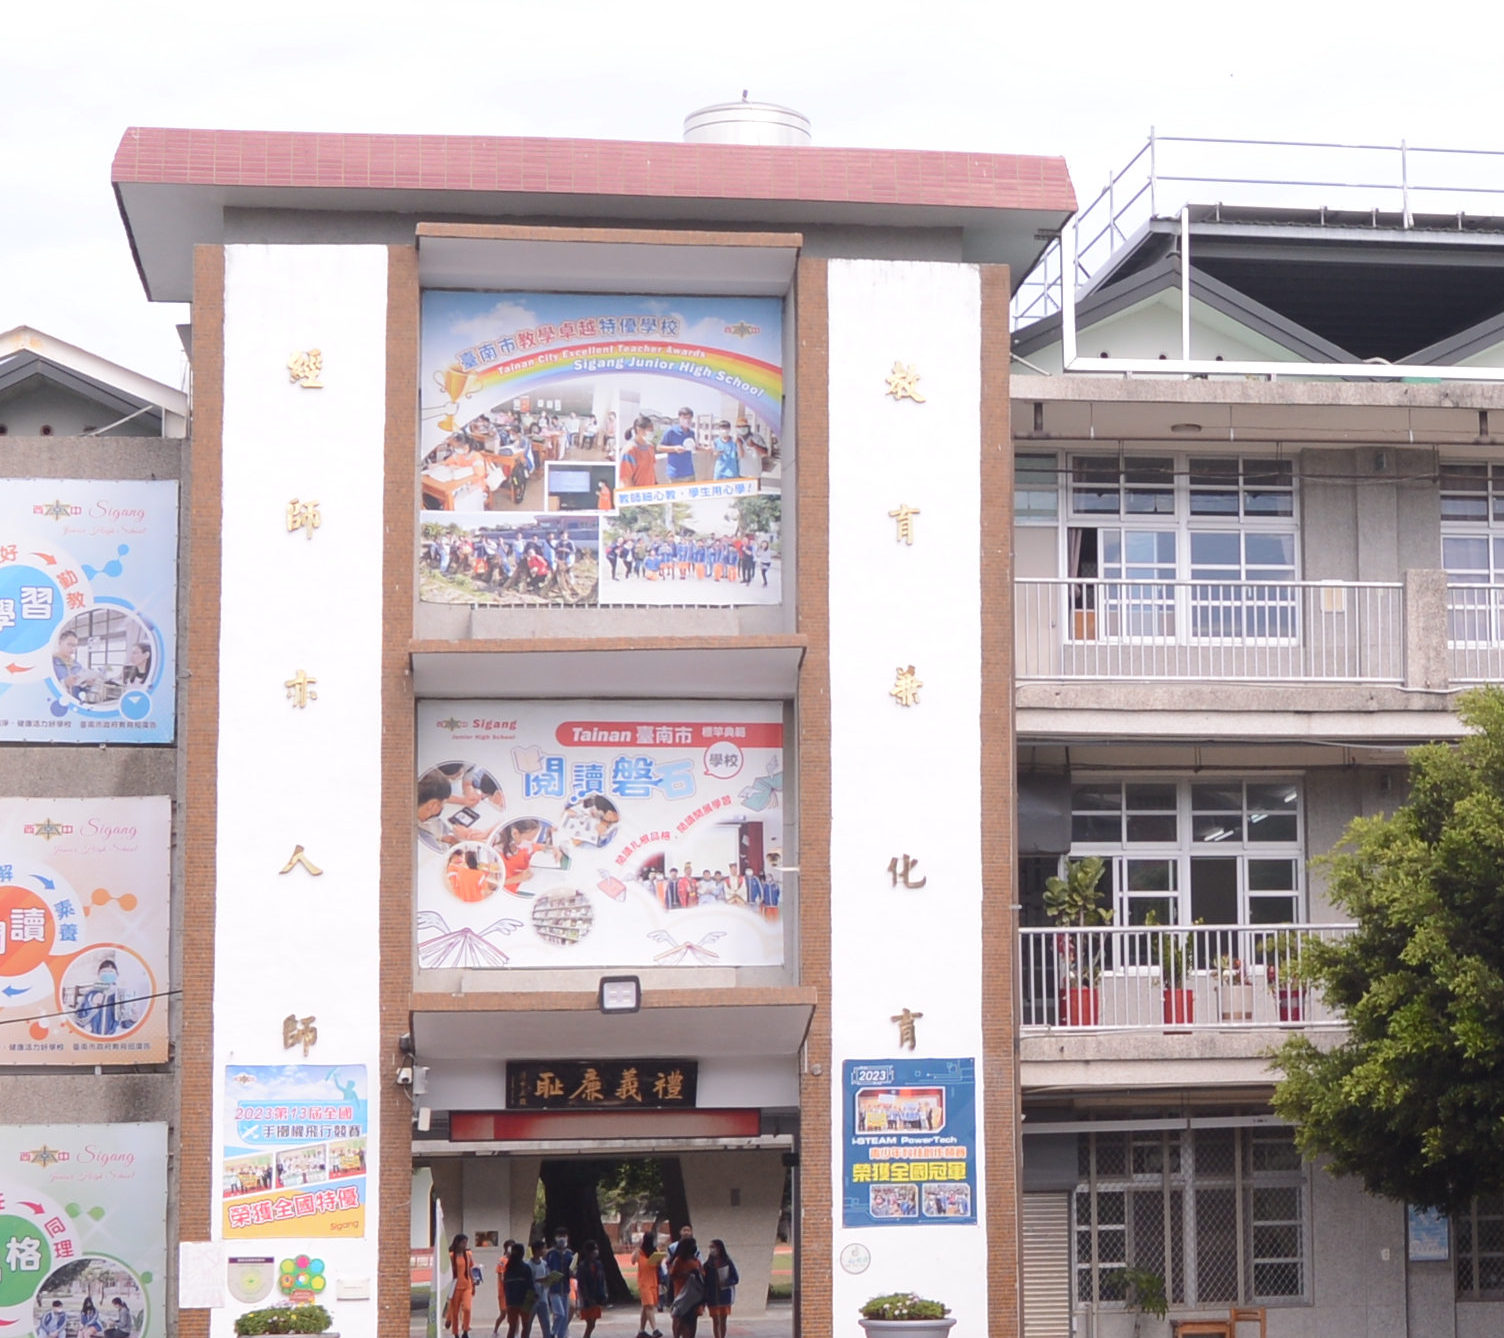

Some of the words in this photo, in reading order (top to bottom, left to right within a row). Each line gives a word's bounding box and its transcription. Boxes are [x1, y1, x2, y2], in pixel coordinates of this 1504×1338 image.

[457, 317, 679, 369] 臺南市教學卓越特優學校
[497, 359, 535, 376] Tainan
[538, 353, 559, 364] City
[562, 346, 614, 359] Excellent
[618, 344, 662, 354] Teacher
[666, 345, 706, 358] Awards
[573, 357, 624, 371] Sigang
[628, 356, 675, 370] Junior
[679, 361, 712, 377] High
[715, 370, 765, 398] School
[88, 500, 145, 522] Sigang
[56, 569, 86, 609] 勤教
[472, 719, 517, 730] Sigang
[572, 726, 632, 742] Tainan
[636, 726, 693, 744] 臺南市
[709, 753, 739, 768] 學校
[524, 755, 695, 800] 閱讀磐石
[80, 817, 137, 840] Sigang
[54, 898, 78, 942] 素養
[858, 1070, 887, 1081] 2023
[235, 1107, 352, 1120] 2023第13屆全國
[77, 1145, 134, 1167] Sigang
[852, 1162, 967, 1182] 榮獲全國冠軍
[228, 1186, 358, 1228] 榮獲全國特優
[330, 1221, 359, 1231] Sigang
[44, 1216, 74, 1259] 同理
